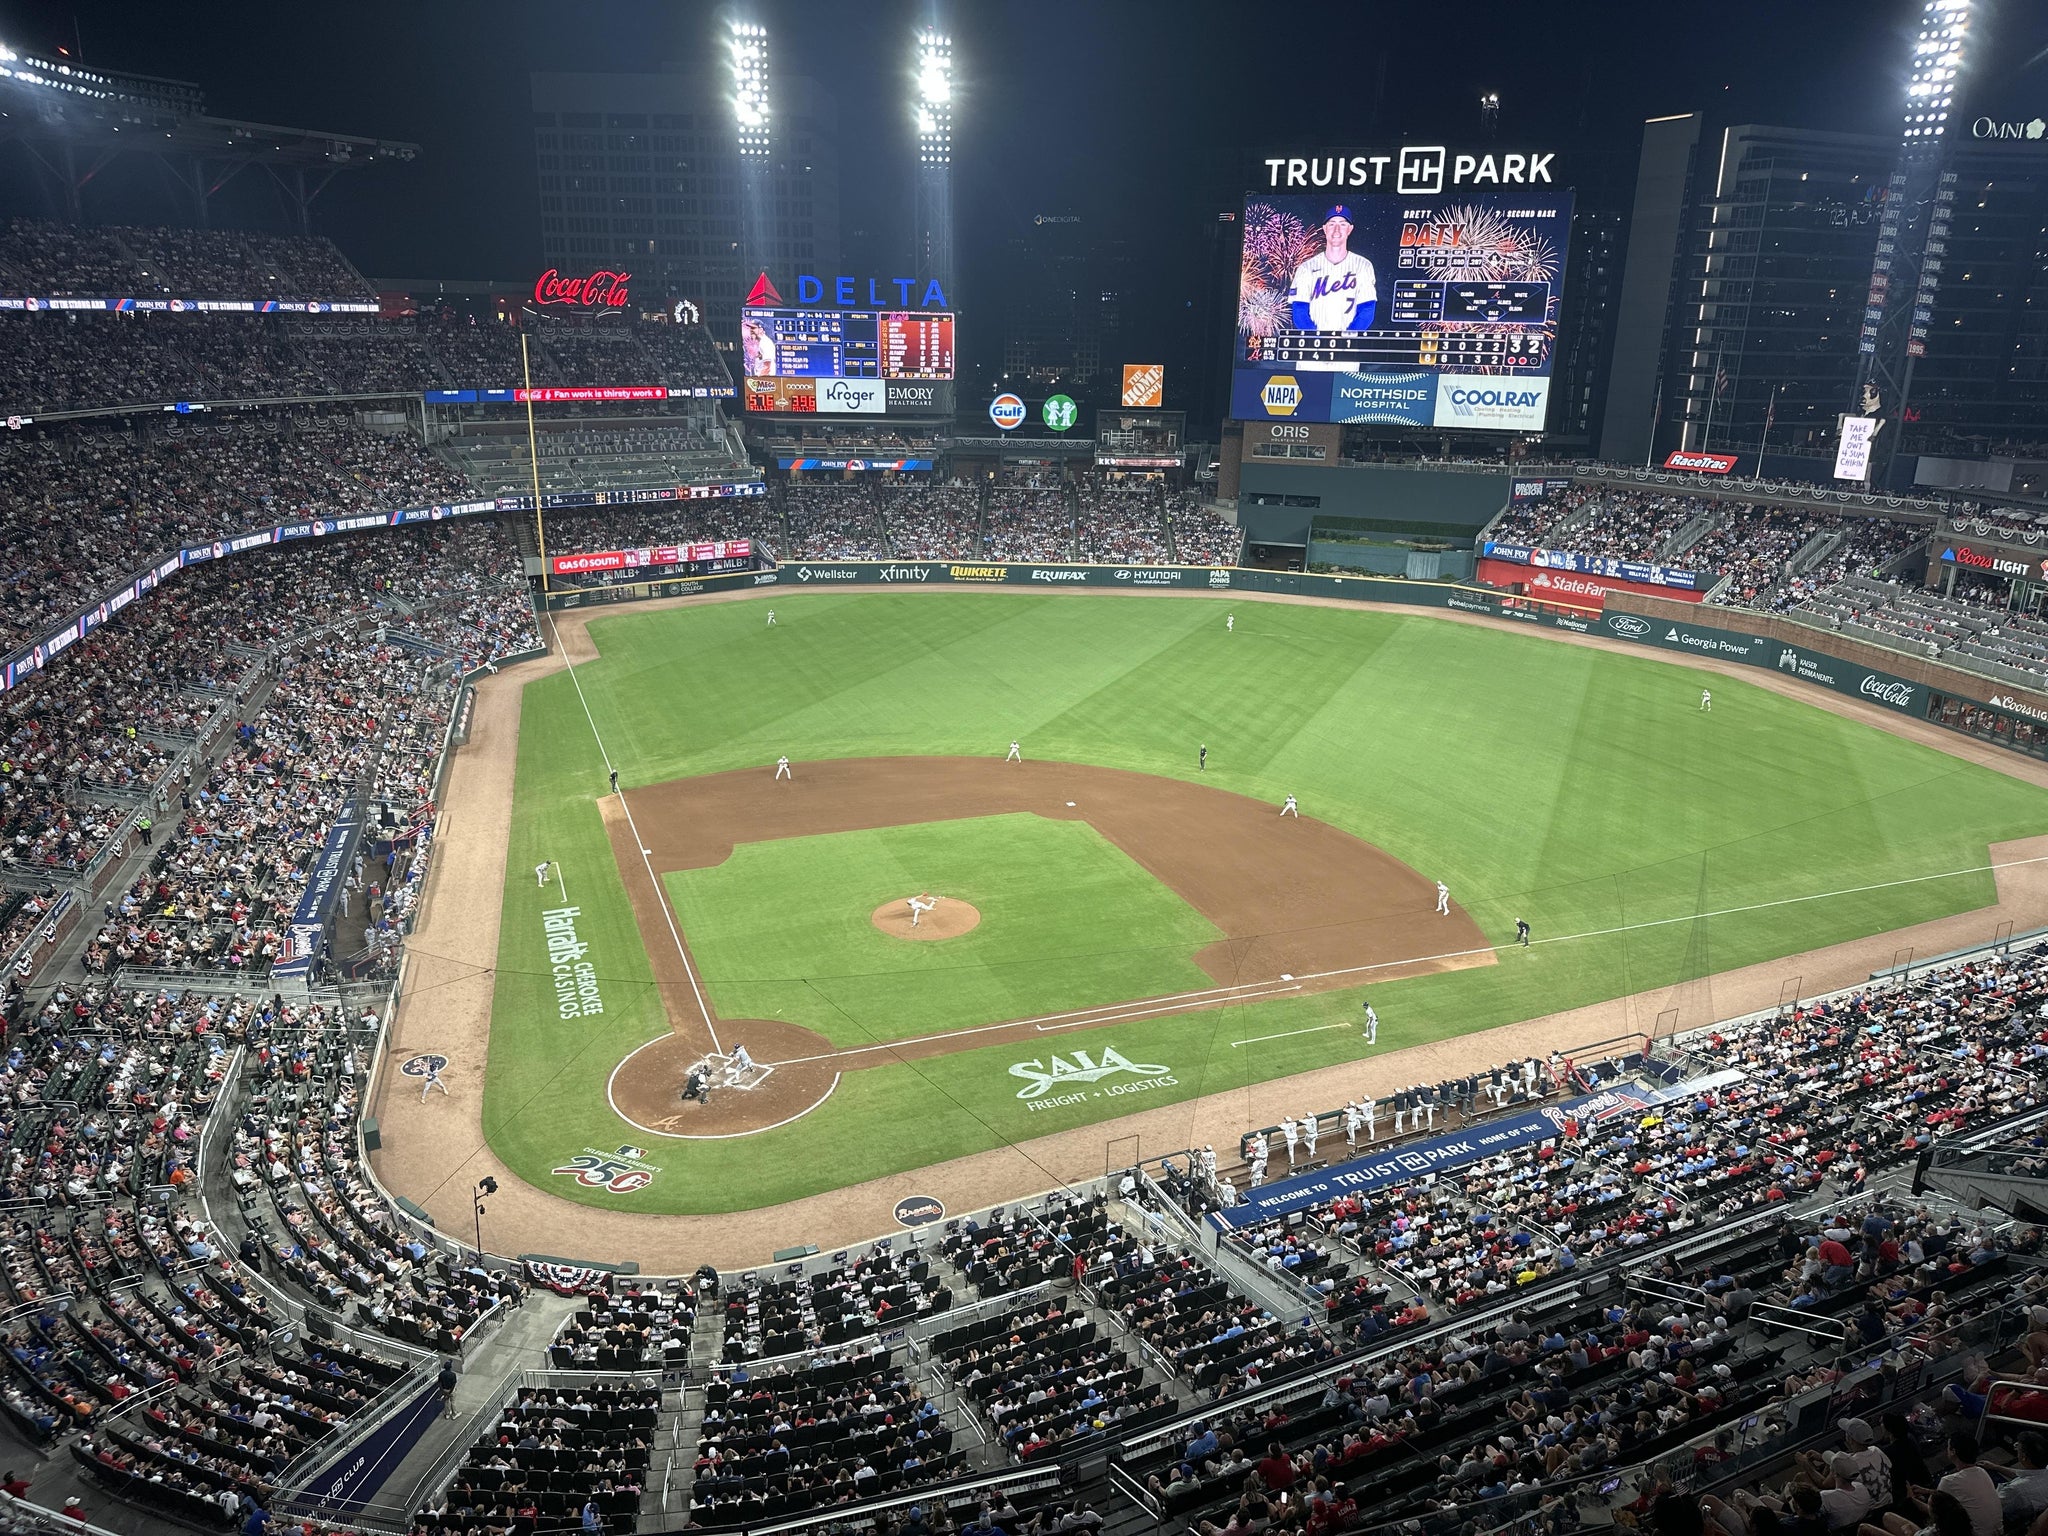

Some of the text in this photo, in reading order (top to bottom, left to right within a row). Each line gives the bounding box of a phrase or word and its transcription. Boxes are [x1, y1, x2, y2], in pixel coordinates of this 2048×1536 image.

[1973, 117, 2025, 139] OMNI
[1265, 153, 1555, 186] TRUIST PARK
[1404, 210, 1432, 218] BRETT
[1886, 210, 1900, 219] 1877
[1400, 223, 1467, 246] BATY
[1932, 226, 1946, 236] 1891
[1876, 260, 1890, 270] 1897
[1310, 272, 1356, 300] Mets
[1873, 277, 1887, 286] 1914
[535, 269, 632, 307] Coca-Cola
[798, 275, 948, 308] DELTA
[1870, 294, 1884, 303] 1957
[1918, 294, 1934, 304] 1958
[1344, 298, 1355, 314] 7
[1867, 310, 1881, 320] 1969
[1864, 326, 1878, 336] 1991
[1912, 328, 1927, 338] 1992
[1443, 342, 1448, 350] 3
[1459, 342, 1465, 350] 0
[1476, 342, 1482, 350] 2
[1493, 343, 1499, 351] 2
[1510, 341, 1539, 353] 3 2
[1860, 343, 1875, 352] 1993
[1908, 344, 1924, 354] 1995
[1313, 352, 1320, 360] 4
[1128, 370, 1144, 386] THE
[1124, 366, 1163, 405] HOME
[604, 389, 630, 399] thirsty
[632, 389, 653, 397] work
[827, 381, 874, 409] Kroger
[888, 388, 934, 399] EMORY
[1138, 379, 1162, 405] DEPOT
[1268, 387, 1296, 404] NAPA
[1340, 388, 1428, 401] NORTHSIDE
[749, 395, 774, 406] 576
[792, 396, 815, 406] 396
[1452, 390, 1542, 407] COOLRAY
[992, 406, 1023, 416] Gulf
[1355, 402, 1410, 410] HOSPITAL
[1271, 426, 1309, 438] ORIS
[1670, 455, 1728, 469] RaceTrac
[284, 525, 310, 536] JOHN FOY
[1492, 547, 1529, 558] JOHN FOY
[559, 557, 619, 570] GAS SOUTH
[624, 555, 637, 563] AL
[723, 559, 747, 569] MLB+
[1551, 555, 1563, 565] NL
[1956, 547, 2030, 575] Coors LIGHT
[614, 569, 640, 578] MLB+
[814, 569, 858, 579] Wellstar
[879, 565, 930, 582] xfinity
[950, 566, 1008, 578] QUIKRETE
[1032, 570, 1088, 581] EQUIFAX
[1134, 571, 1181, 580] HYUNDAI
[1563, 619, 1588, 629] National
[1615, 617, 1643, 633] Ford
[1681, 634, 1749, 655] Georgia Power
[1800, 659, 1817, 670] KAISER
[1798, 667, 1834, 684] PERMANENTE
[1860, 675, 1915, 706] Coca-Cola
[2002, 696, 2048, 721] Coors LIG
[542, 906, 589, 963] Harrah's
[552, 965, 580, 1019] CASINOS
[574, 962, 603, 1016] CHEROKEE
[1008, 1046, 1170, 1099] SAIA
[1026, 1076, 1179, 1112] FREIGHT LOGISTICS
[1258, 1091, 1620, 1208] WELCOME TO TRUIST PARK HOME OF THE Braves
[344, 1456, 365, 1482] CLUB
